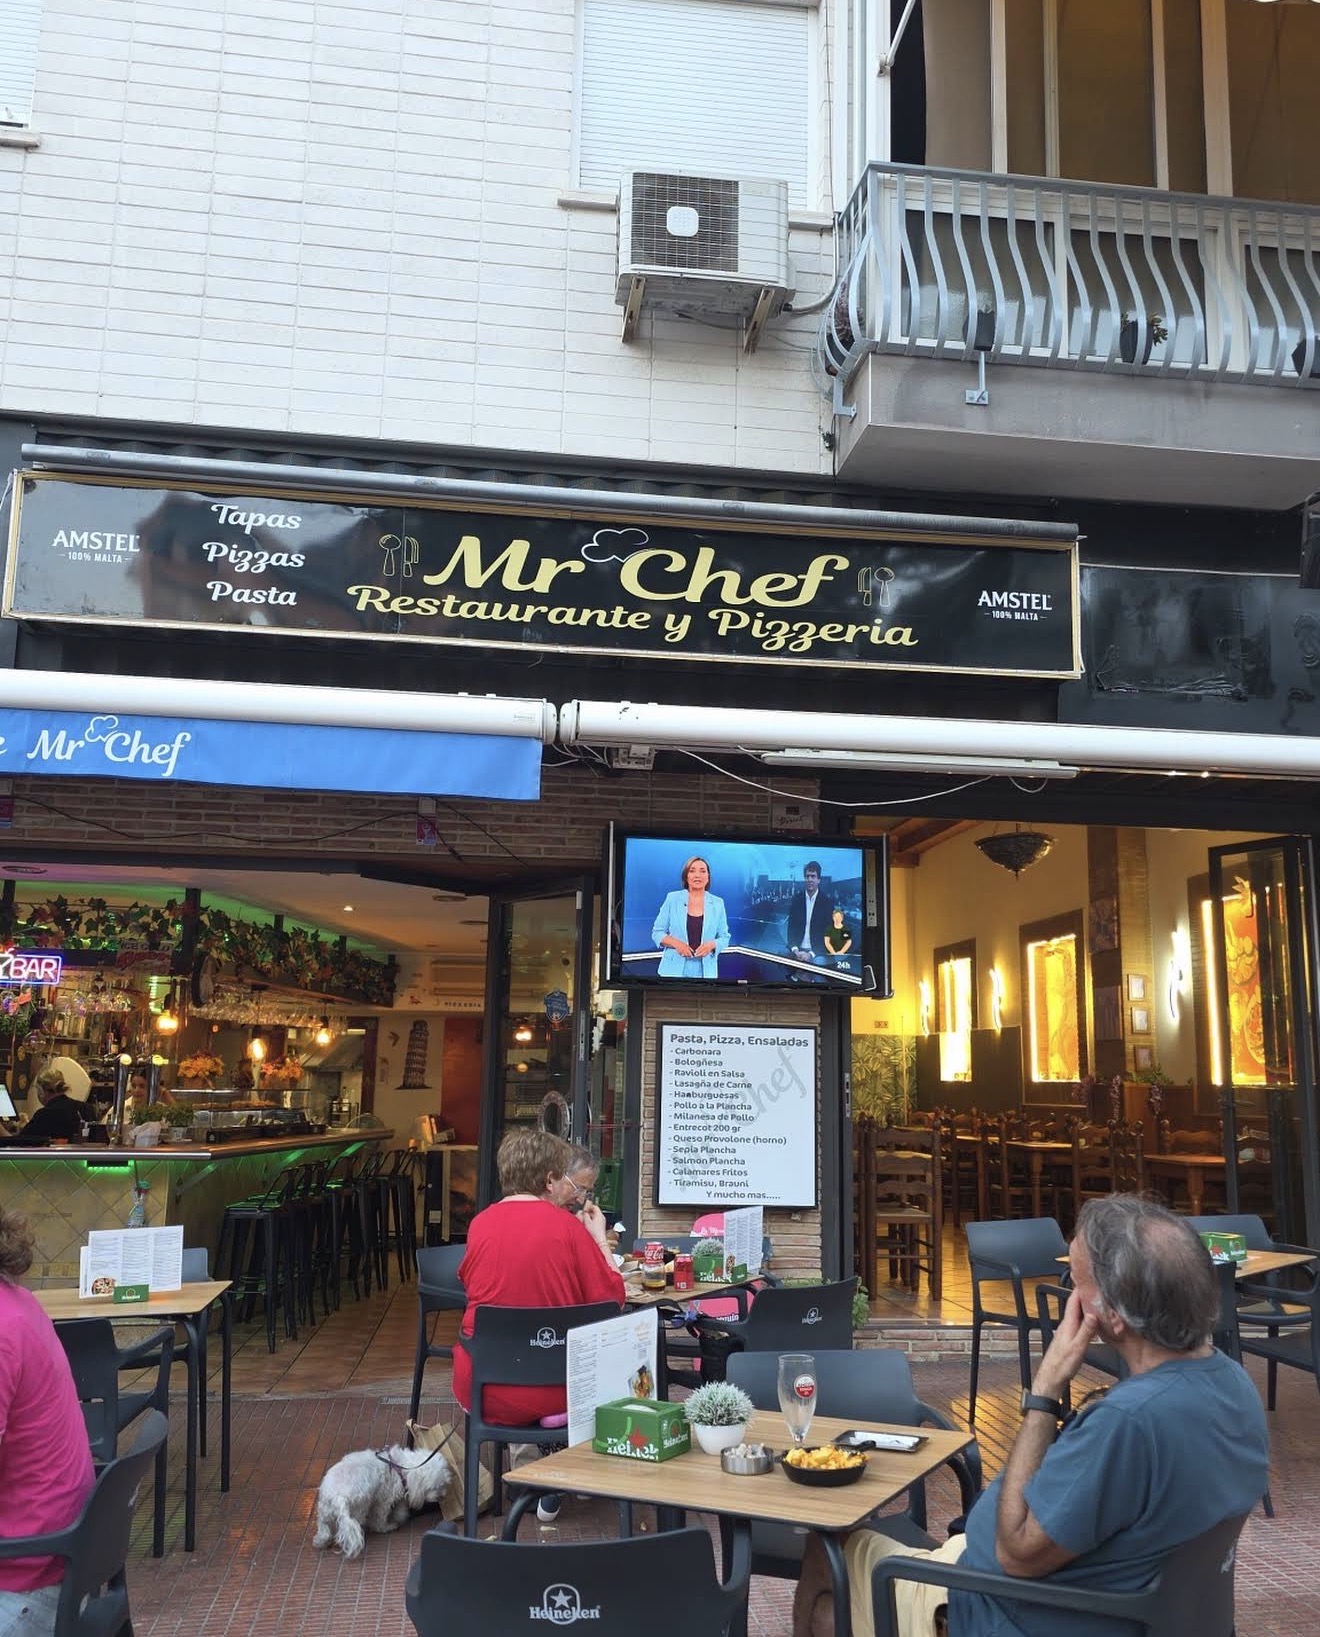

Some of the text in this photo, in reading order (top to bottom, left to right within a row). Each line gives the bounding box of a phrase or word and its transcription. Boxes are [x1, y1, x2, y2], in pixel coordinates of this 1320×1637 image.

[210, 503, 302, 535] Tapas
[51, 530, 141, 552] AMSTEL
[68, 551, 122, 563] 100% MALTA
[201, 540, 306, 574] Pizzas
[423, 535, 850, 608] Mr Chef
[206, 580, 298, 606] Pasta
[977, 590, 1053, 611] AMSTEL
[346, 585, 919, 652] Restaurante y Pizzeria
[992, 610, 1039, 621] 100% MALTA
[26, 729, 86, 761] Mr
[104, 730, 192, 777] Chef
[9, 957, 57, 980] BAR
[837, 961, 851, 969] 24h
[670, 1033, 809, 1047] Pasta, Pizza, Ensaladas
[674, 1047, 721, 1056] Carbonara
[674, 1068, 707, 1077] Ravioli
[721, 1070, 745, 1078] Salsa
[726, 1081, 753, 1089] Carne
[673, 1101, 698, 1109] Pollo
[706, 1102, 715, 1110] la
[716, 1102, 752, 1110] Plancha
[673, 1112, 754, 1121] Milanesa de Pollo
[673, 1123, 712, 1132] Entrecot
[713, 1124, 730, 1132] 200
[673, 1134, 787, 1145] Queso Provolone (horno)
[672, 1145, 736, 1154] Sepia Plancha
[672, 1156, 746, 1165] Salmon Plancha
[672, 1168, 748, 1177] Calamares Fritos
[673, 1179, 717, 1188] Tiramisu,
[713, 1190, 746, 1198] mucho
[528, 1606, 601, 1620] Heineken
